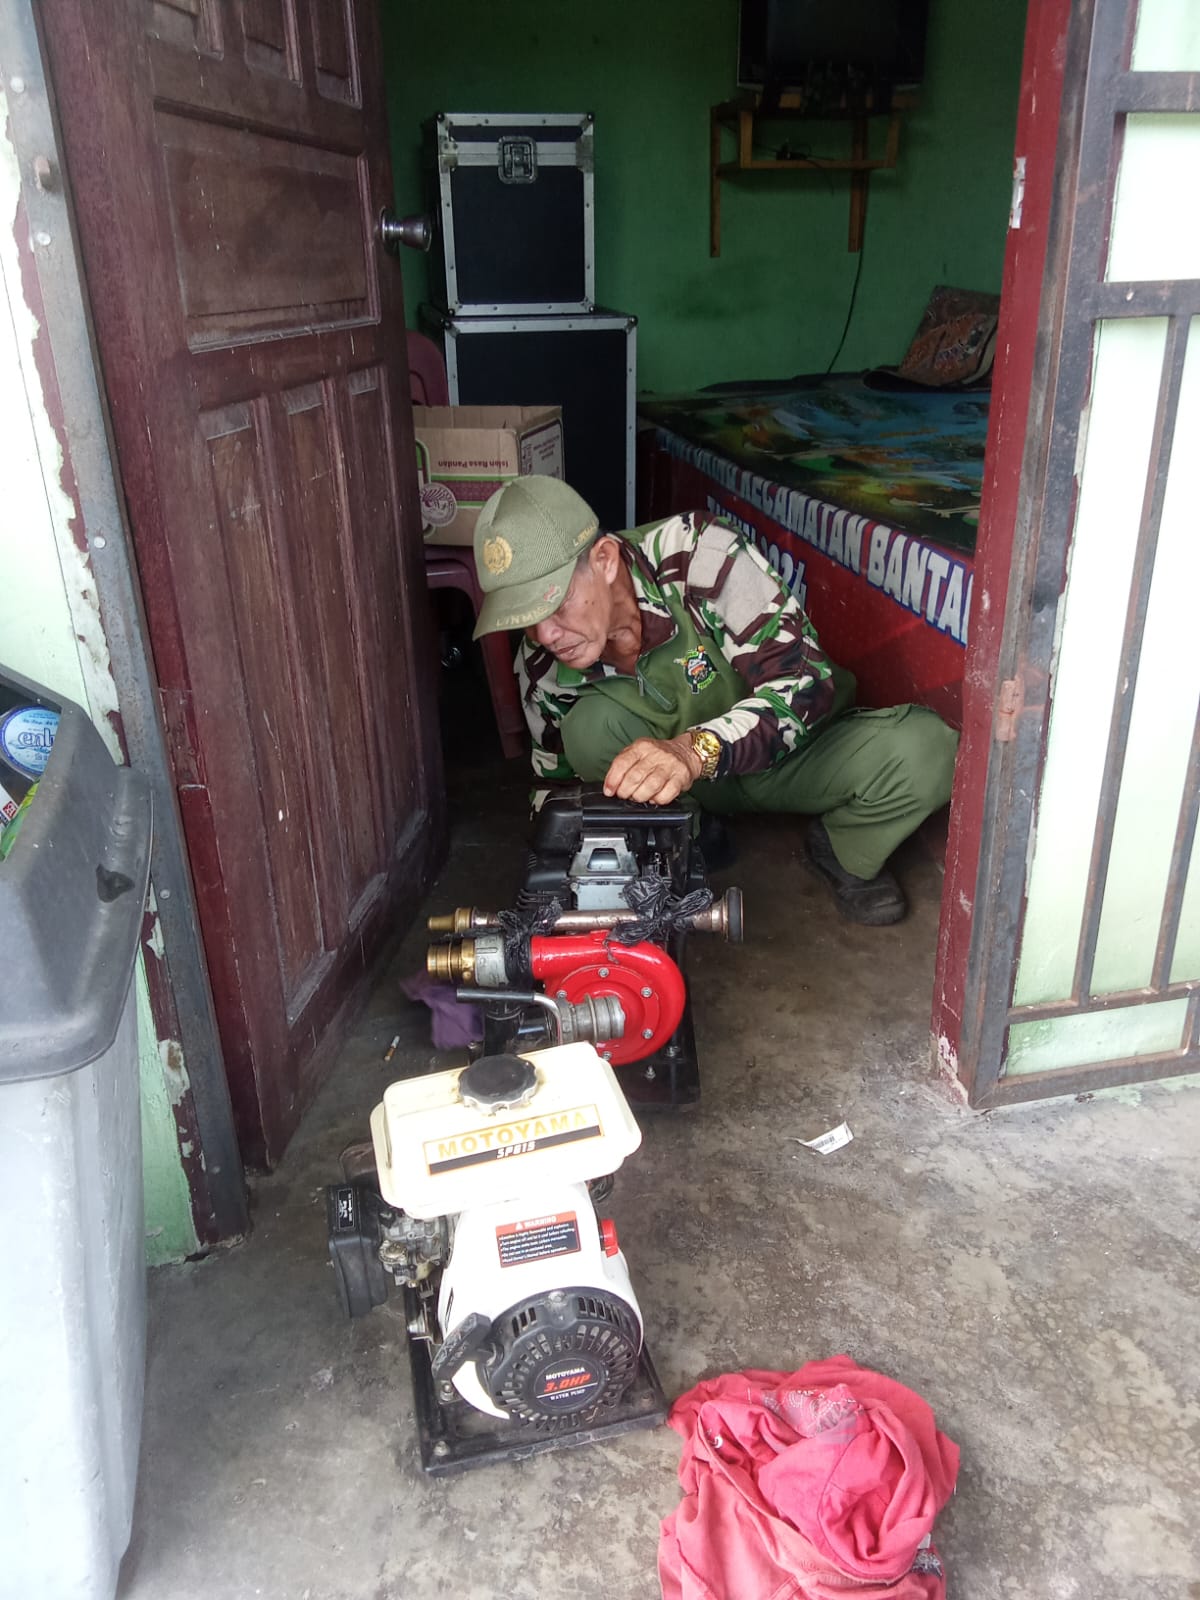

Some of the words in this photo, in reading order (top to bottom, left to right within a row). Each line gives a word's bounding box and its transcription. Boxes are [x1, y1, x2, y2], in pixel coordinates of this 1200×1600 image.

[437, 1111, 588, 1160] MOTOYAMA
[544, 1373, 592, 1393] 3.0HP
[545, 1366, 586, 1381] MOTOYAMA
